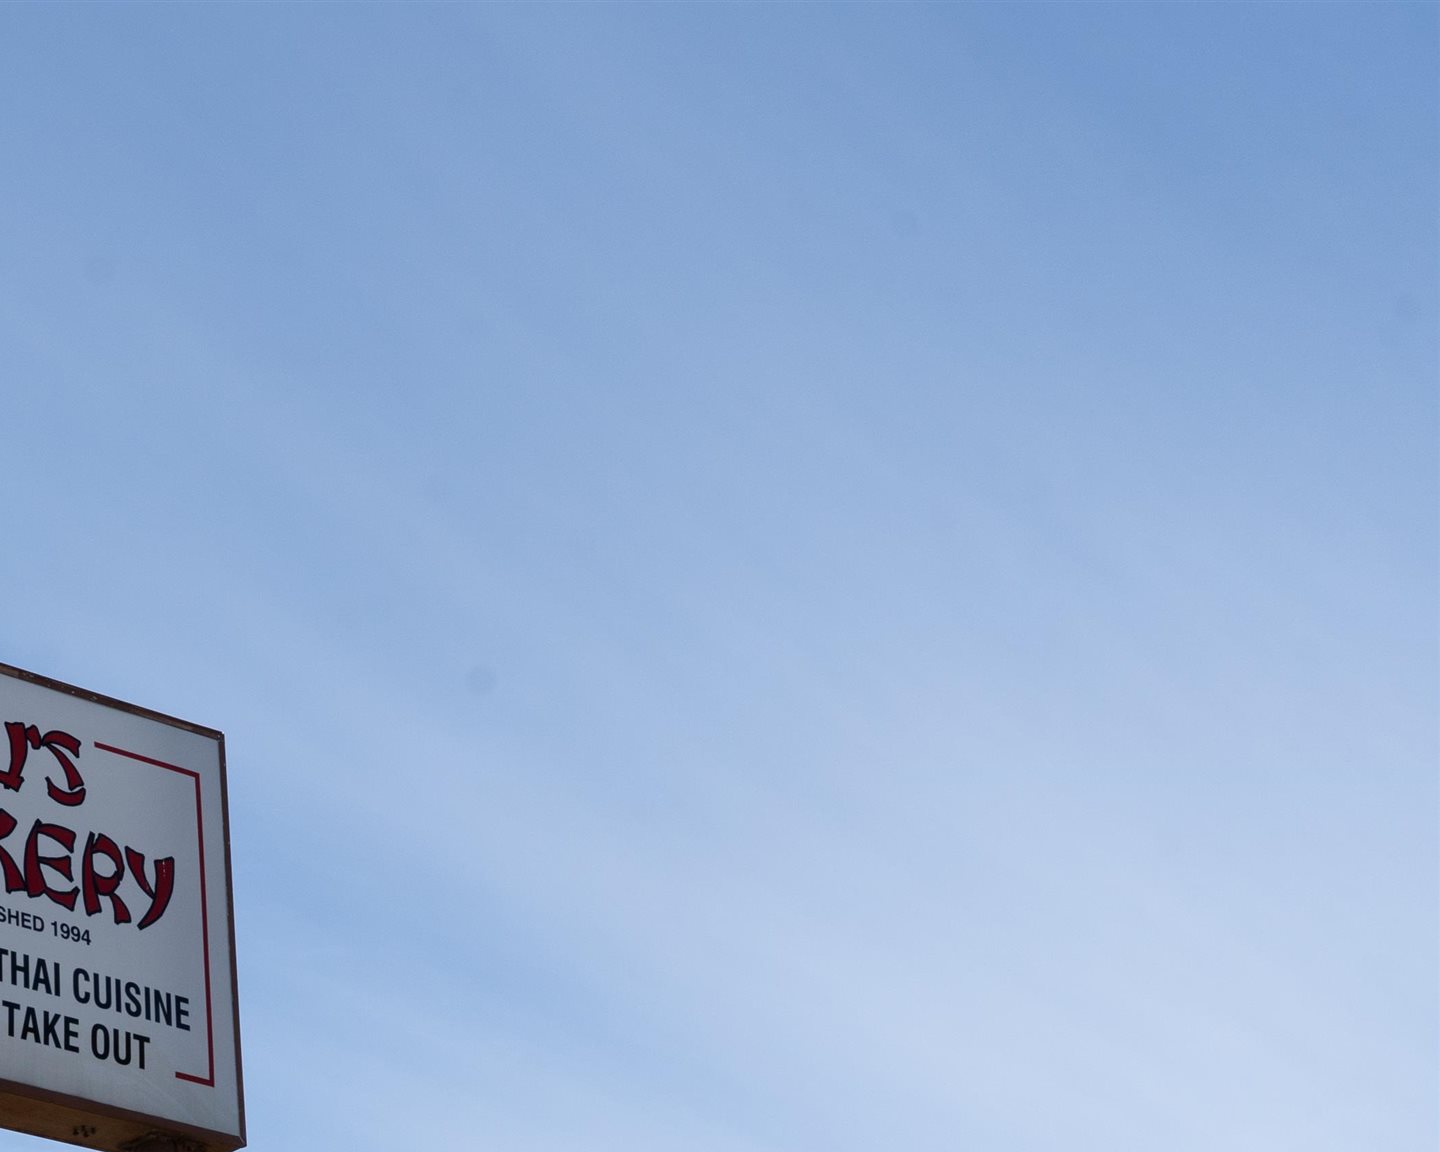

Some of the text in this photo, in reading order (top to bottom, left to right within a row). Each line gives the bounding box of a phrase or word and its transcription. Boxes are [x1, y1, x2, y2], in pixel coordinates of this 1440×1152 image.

[50, 920, 92, 946] 1994
[72, 968, 191, 1032] CUISINE
[2, 1003, 80, 1054] TAKE
[90, 1025, 151, 1070] OUT
